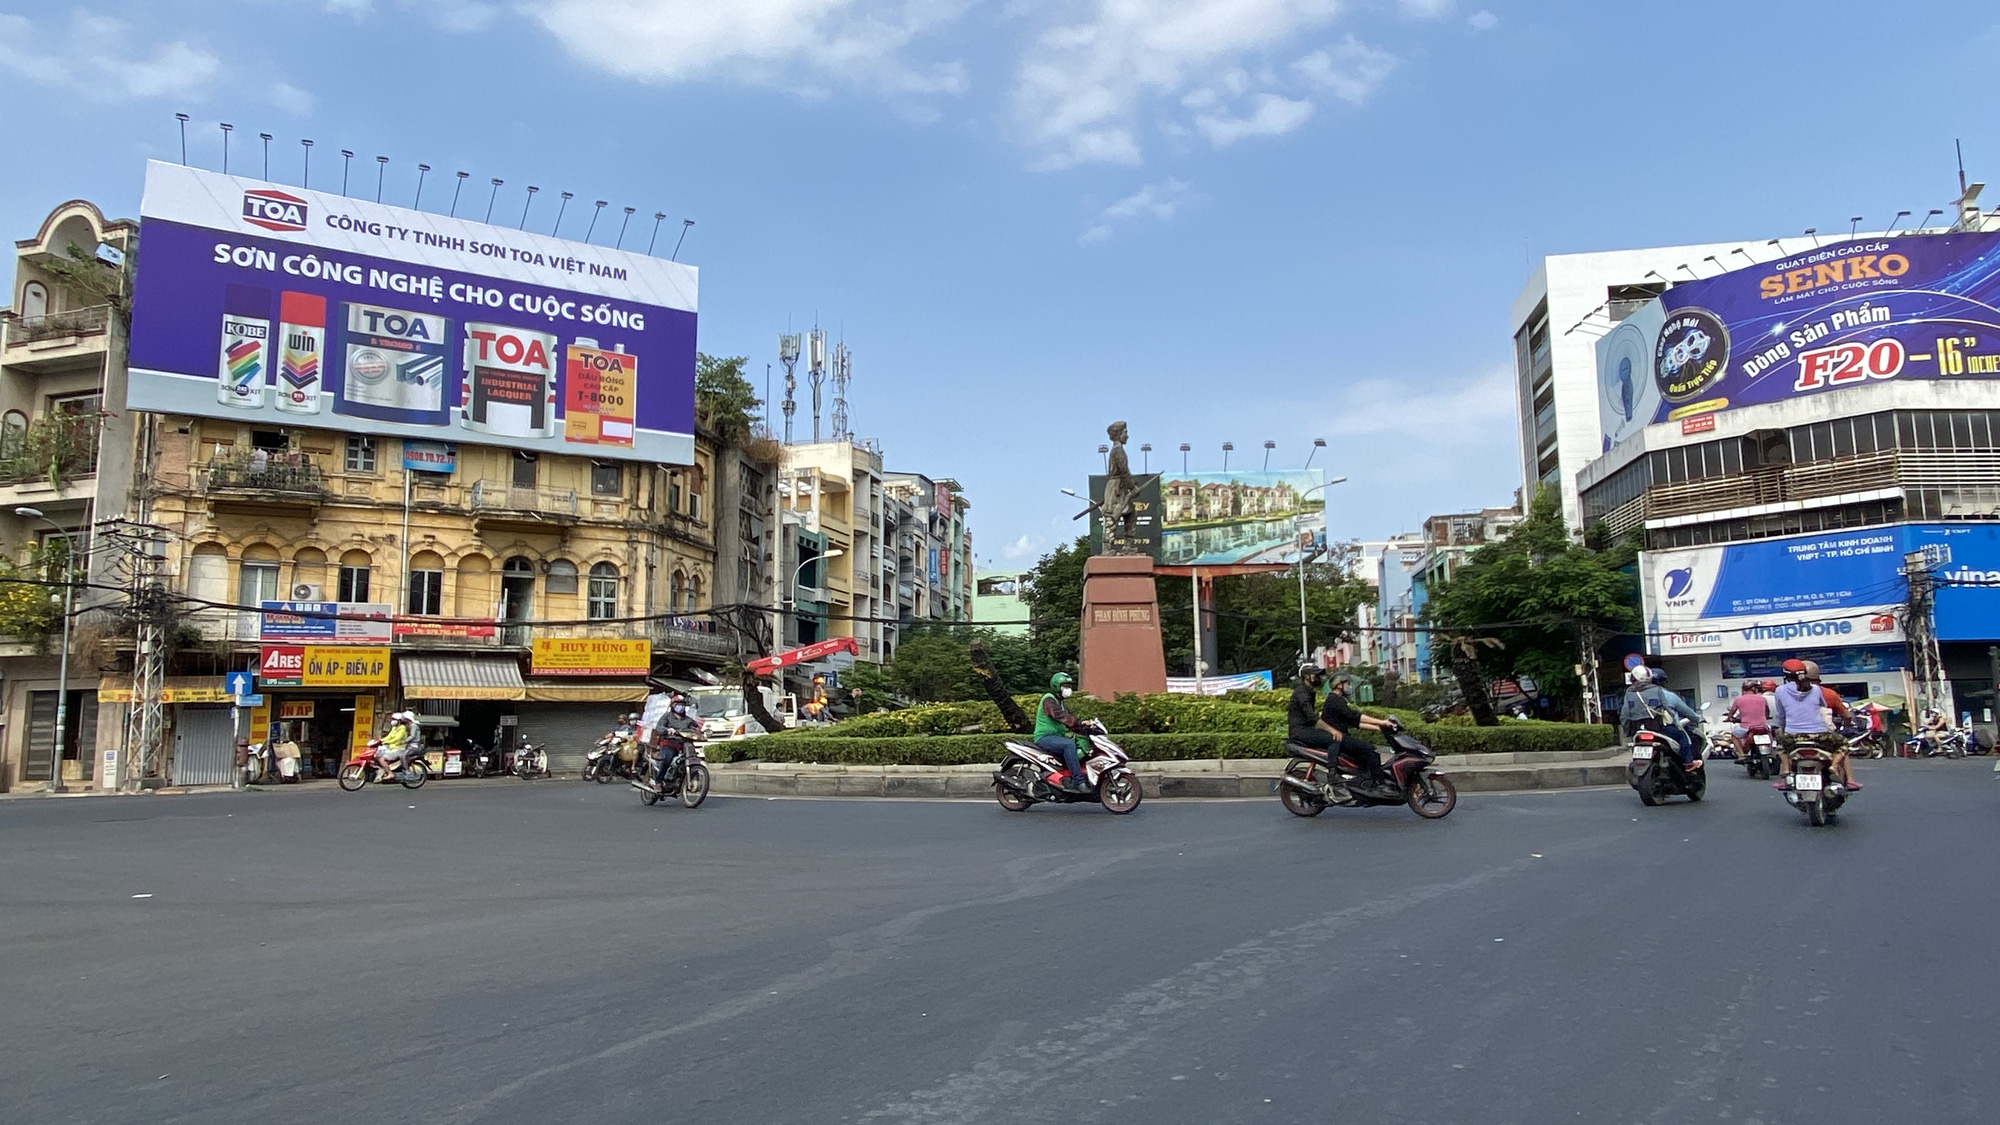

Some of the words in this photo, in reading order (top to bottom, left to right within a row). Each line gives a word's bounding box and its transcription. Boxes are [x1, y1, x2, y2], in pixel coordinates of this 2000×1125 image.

[247, 197, 303, 224] TOA
[325, 214, 382, 236] CÔNG
[385, 224, 409, 241] TY
[412, 229, 465, 249] TNHH
[468, 241, 506, 259] SƠN
[509, 247, 545, 267] TOA
[549, 255, 586, 275] VIỆT
[589, 262, 627, 281] NAM
[1776, 257, 1806, 271] QUẠT
[1808, 250, 1836, 263] ĐIỆN
[1837, 245, 1864, 256] CAO
[1865, 242, 1890, 252] CẤP
[213, 243, 276, 272] SƠN
[282, 253, 362, 285] CÔNG
[369, 268, 444, 303] NGHỆ
[449, 282, 503, 308] CHO
[508, 292, 576, 322] CUỘC
[580, 302, 645, 331] SỐNG
[1760, 253, 1910, 299] SENKO
[1817, 285, 1839, 295] CHO
[226, 322, 265, 338] KOBE
[363, 309, 431, 340] TOA
[471, 330, 550, 370] TOA
[1742, 341, 1791, 379] Dòng
[1789, 321, 1829, 348] Sản
[1830, 301, 1891, 331] Phẩm
[580, 352, 623, 374] TOA
[1796, 340, 1904, 390] F20
[481, 377, 539, 392] INDUSTRIAL
[487, 388, 532, 401] LACQUER
[577, 390, 624, 406] T-8000
[1787, 543, 1817, 553] TRUNG
[1818, 541, 1837, 550] TÂM
[1838, 539, 1859, 548] KINH
[1861, 536, 1893, 546] DOANH
[1796, 552, 1820, 561] VNPT
[1871, 545, 1894, 554] MINH
[1665, 599, 1695, 608] VNPT
[1742, 619, 1852, 641] vinaphone
[560, 642, 588, 653] HUY
[592, 641, 628, 653] HÙNG
[309, 655, 322, 675] ỔN
[326, 658, 339, 675] ÁP
[345, 657, 368, 675] BIẾN
[370, 658, 384, 675] ÁP
